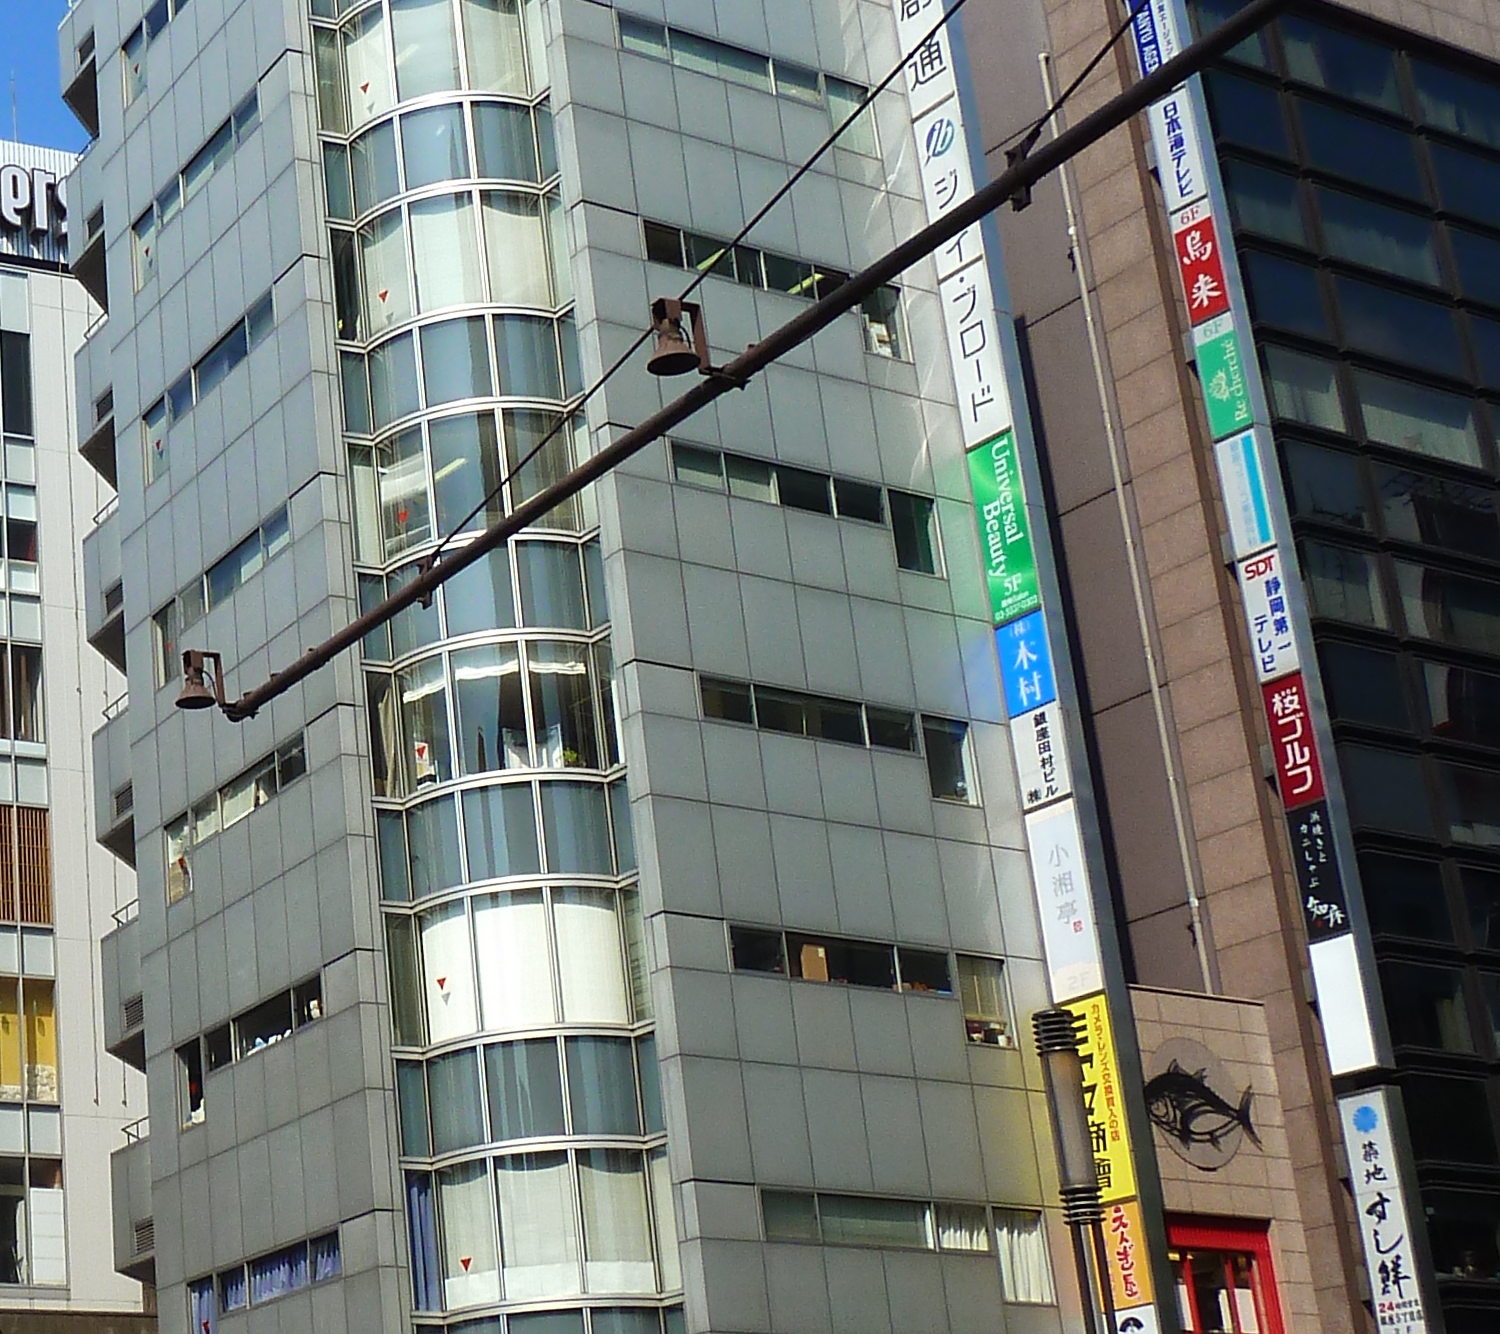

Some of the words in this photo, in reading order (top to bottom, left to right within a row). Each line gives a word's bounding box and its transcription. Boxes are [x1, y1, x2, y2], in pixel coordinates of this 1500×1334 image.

[1135, 4, 1152, 41] ANYU
[1163, 101, 1193, 198] 日本海テレビ
[1180, 208, 1201, 225] 6F
[934, 169, 994, 423] ジイ・ブロード
[1203, 320, 1223, 340] 6F
[991, 438, 1024, 545] Universal
[983, 500, 1006, 578] Beauty
[1244, 555, 1275, 581] SDT
[1004, 573, 1022, 597] 5F
[1264, 576, 1292, 651] 静岡第一
[1014, 641, 1043, 707] 木村
[1254, 615, 1276, 673] テレビ
[1032, 711, 1059, 799] 銀座田村ビル
[1272, 686, 1314, 796] 桜ゴルフ
[1049, 844, 1078, 925] 小湘亭
